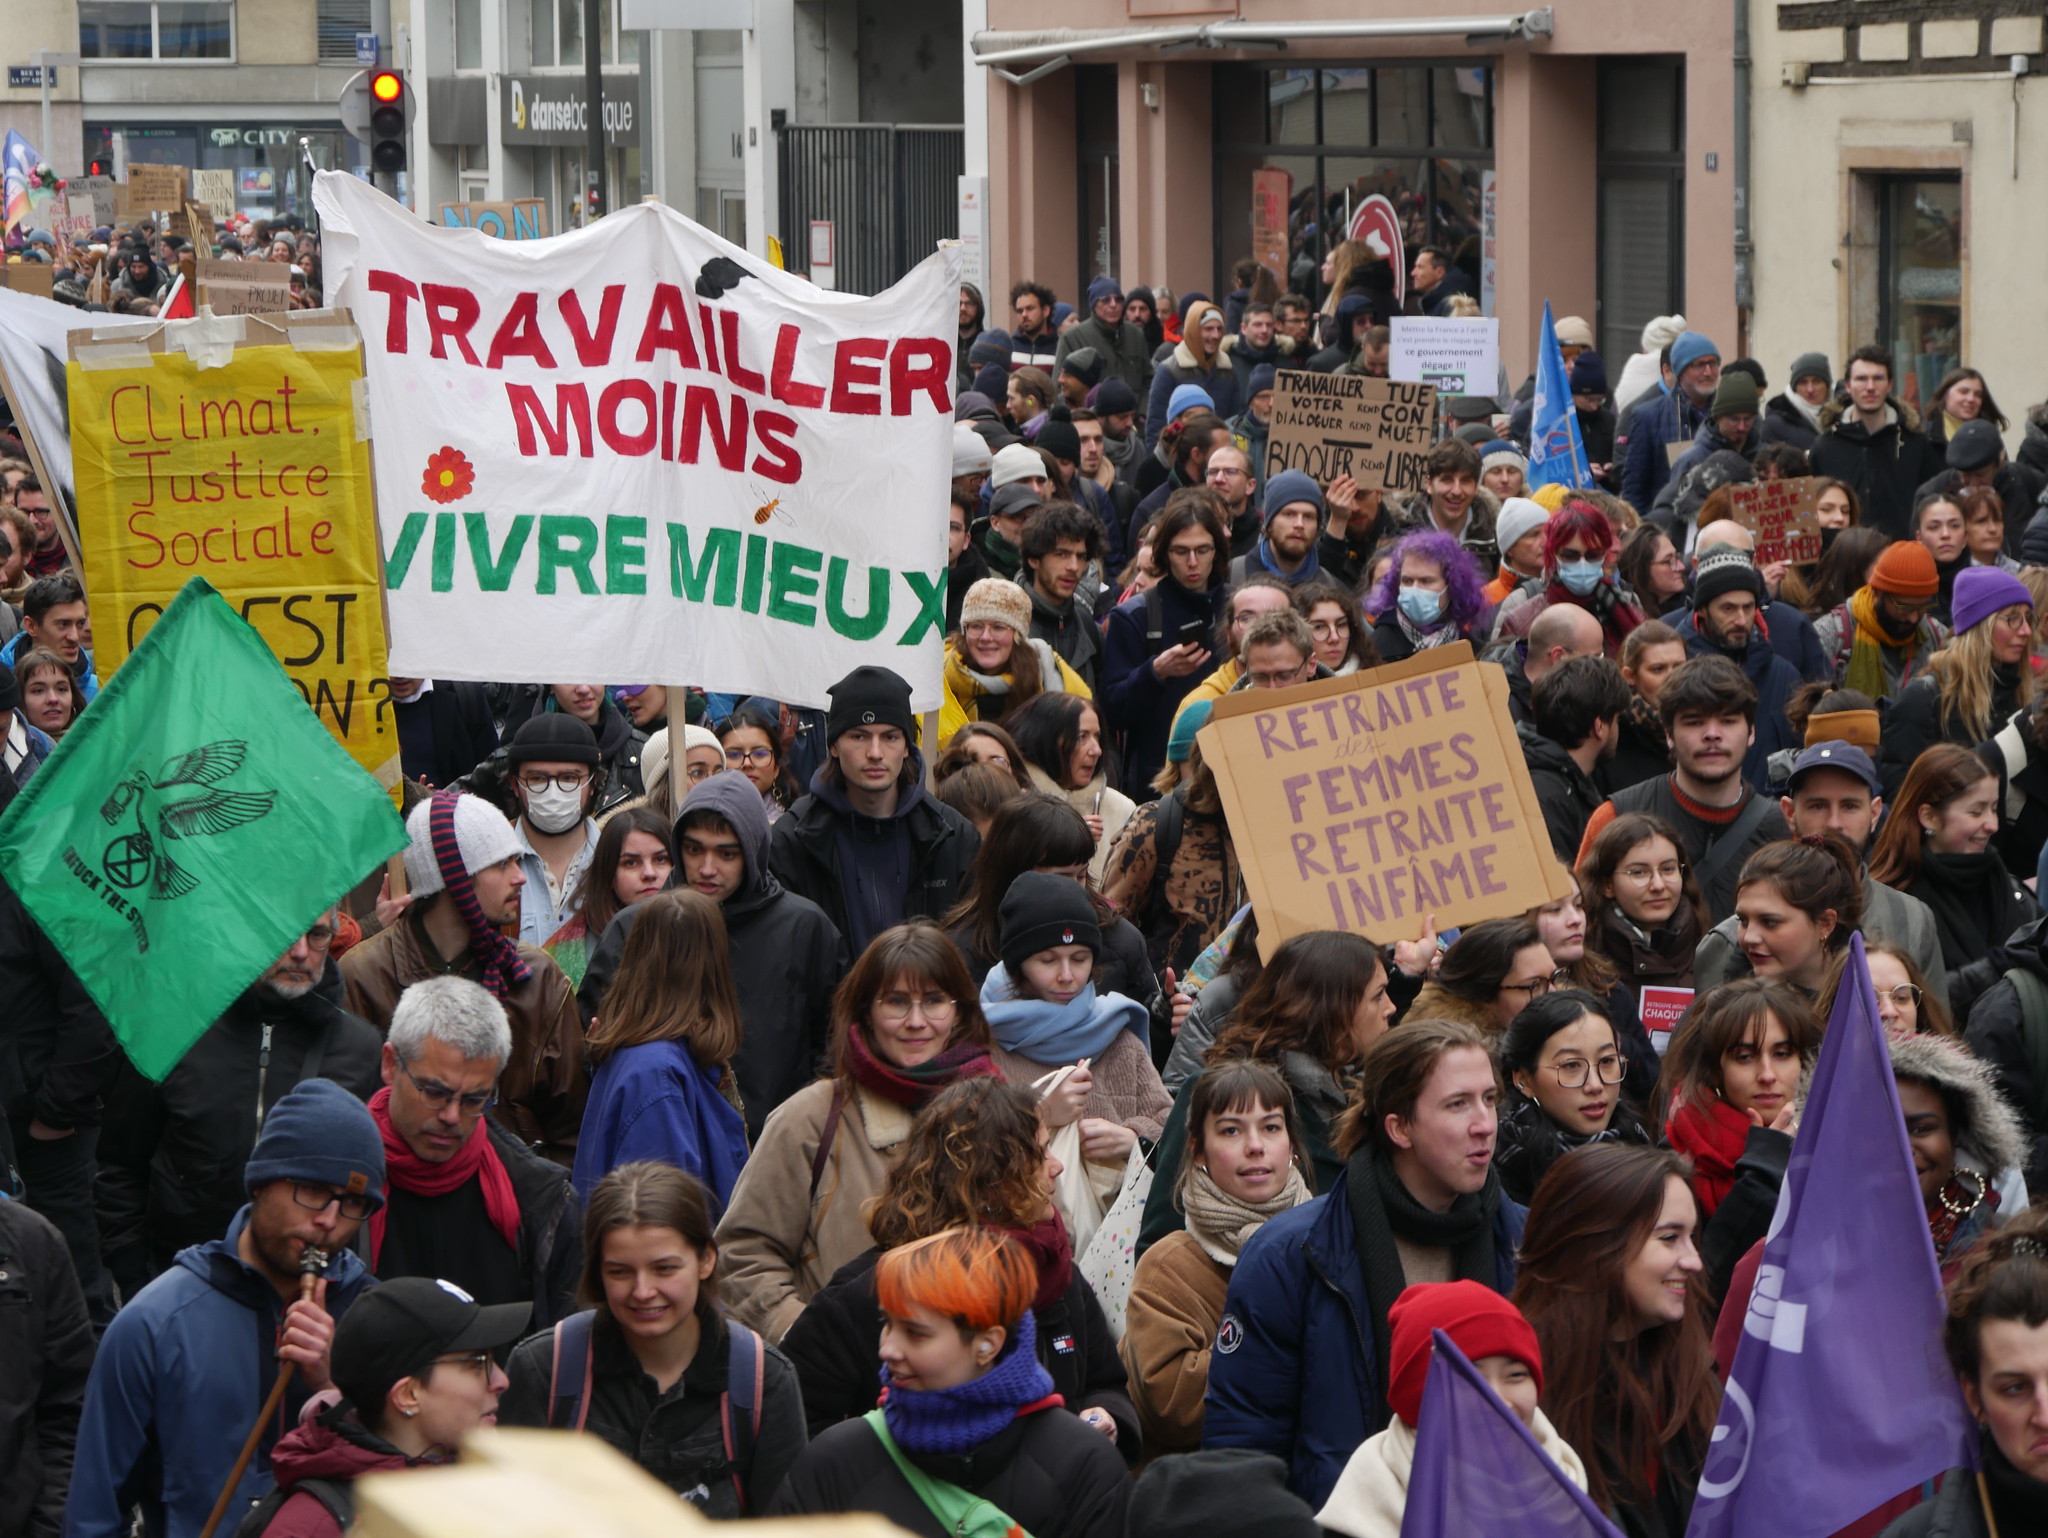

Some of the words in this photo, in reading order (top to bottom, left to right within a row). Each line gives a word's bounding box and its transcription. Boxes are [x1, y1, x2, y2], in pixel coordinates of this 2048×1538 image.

[531, 92, 633, 143] danseboique
[243, 129, 297, 145] CITY
[442, 204, 541, 241] NON
[247, 285, 287, 304] PROJET
[367, 269, 953, 416] TRAVAILLER
[1401, 326, 1425, 334] Mettre
[1435, 326, 1459, 334] France
[1405, 348, 1416, 356] ce
[1417, 347, 1484, 358] gouvernement
[1421, 361, 1454, 371] dégage
[1456, 360, 1467, 370] !!!
[1278, 371, 1364, 399] TRAVAILLER
[1387, 382, 1433, 406] TUE
[110, 375, 320, 445] Climat,
[1276, 410, 1343, 430] DIALOGUER
[1350, 421, 1372, 432] REND
[1378, 422, 1431, 444] MUET
[1292, 396, 1344, 412] VOTER
[1357, 403, 1380, 414] REND
[1381, 403, 1425, 425] CON
[504, 378, 803, 484] MOINS
[128, 450, 330, 508] Justice
[1266, 440, 1354, 483] BLOQUER
[1361, 458, 1385, 471] REND
[1383, 449, 1428, 493] LIBRE
[1734, 488, 1759, 505] PAS
[1767, 483, 1784, 497] DE
[1759, 508, 1796, 528] POUR
[127, 505, 335, 569] Sociale
[384, 512, 648, 596] VIVRE
[666, 521, 949, 647] MIEUX
[1254, 670, 1466, 760] RETRAITE
[1333, 736, 1386, 760] des
[1282, 732, 1480, 824] FEMMES
[1289, 782, 1515, 882] RETRAITE
[99, 884, 129, 914] THE
[1326, 843, 1508, 931] INFÂME
